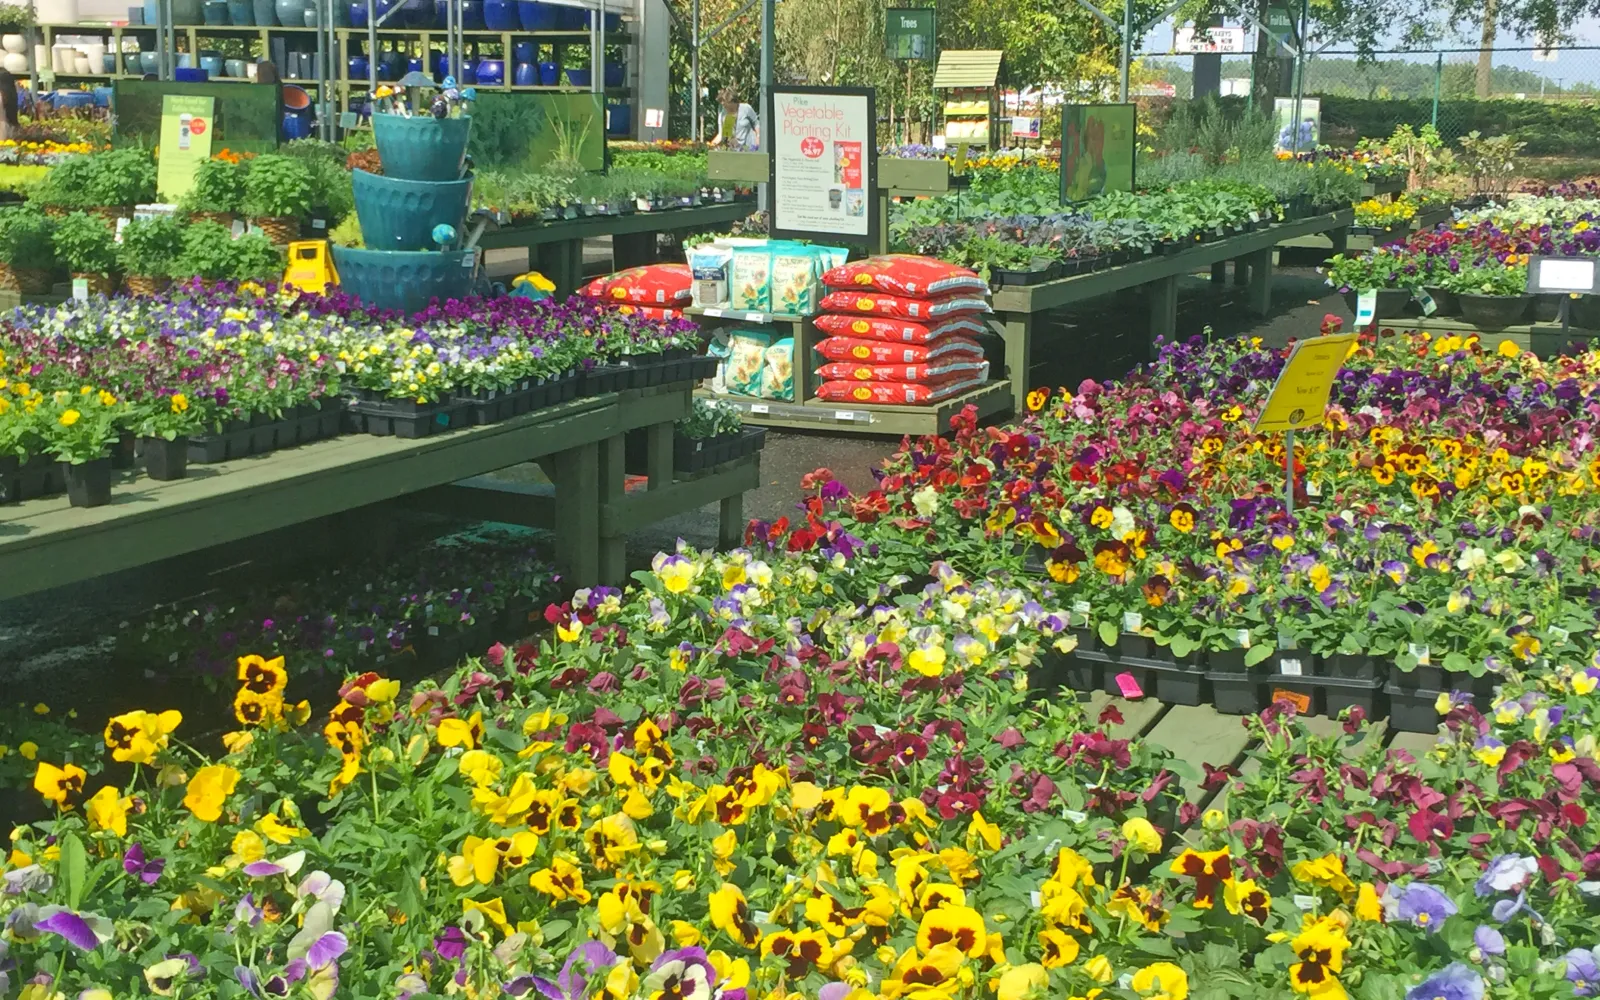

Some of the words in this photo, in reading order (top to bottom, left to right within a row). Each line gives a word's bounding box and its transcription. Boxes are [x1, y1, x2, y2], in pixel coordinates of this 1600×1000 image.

[900, 16, 917, 28] Trees
[793, 96, 808, 106] Pike
[781, 102, 844, 123] Vegetable
[783, 119, 831, 142] Planting
[835, 122, 851, 138] Kit
